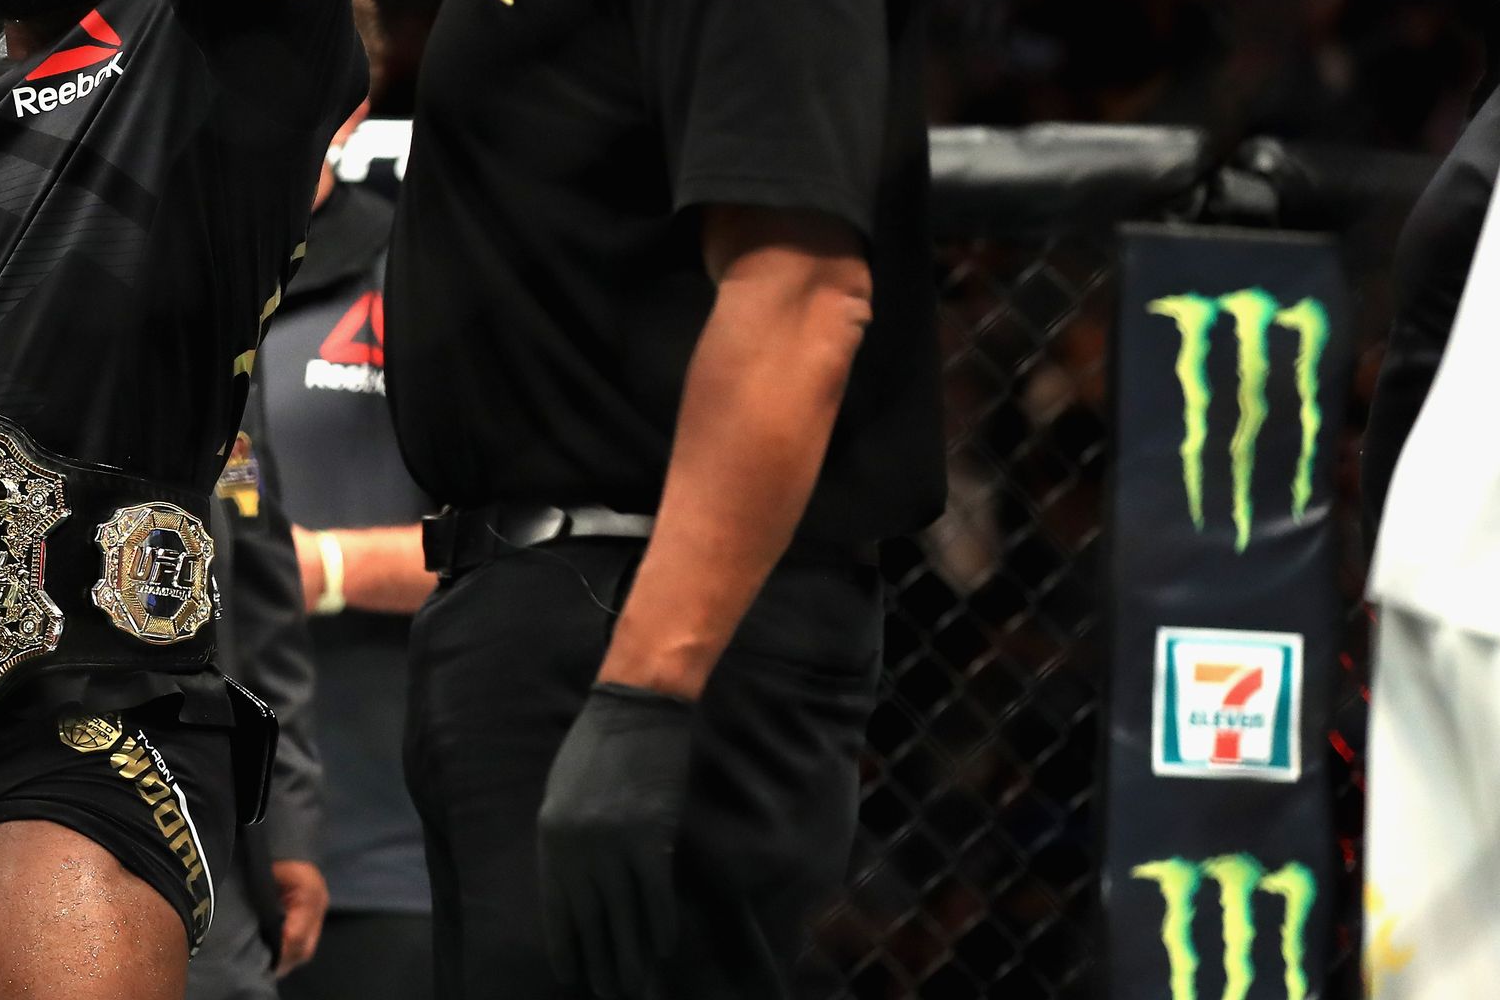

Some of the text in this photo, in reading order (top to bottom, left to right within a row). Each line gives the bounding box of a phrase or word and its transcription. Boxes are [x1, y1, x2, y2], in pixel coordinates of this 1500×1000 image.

[12, 51, 124, 118] Reebok
[129, 545, 197, 590] UFC
[1194, 662, 1263, 764] 7
[135, 729, 174, 783] TYRON
